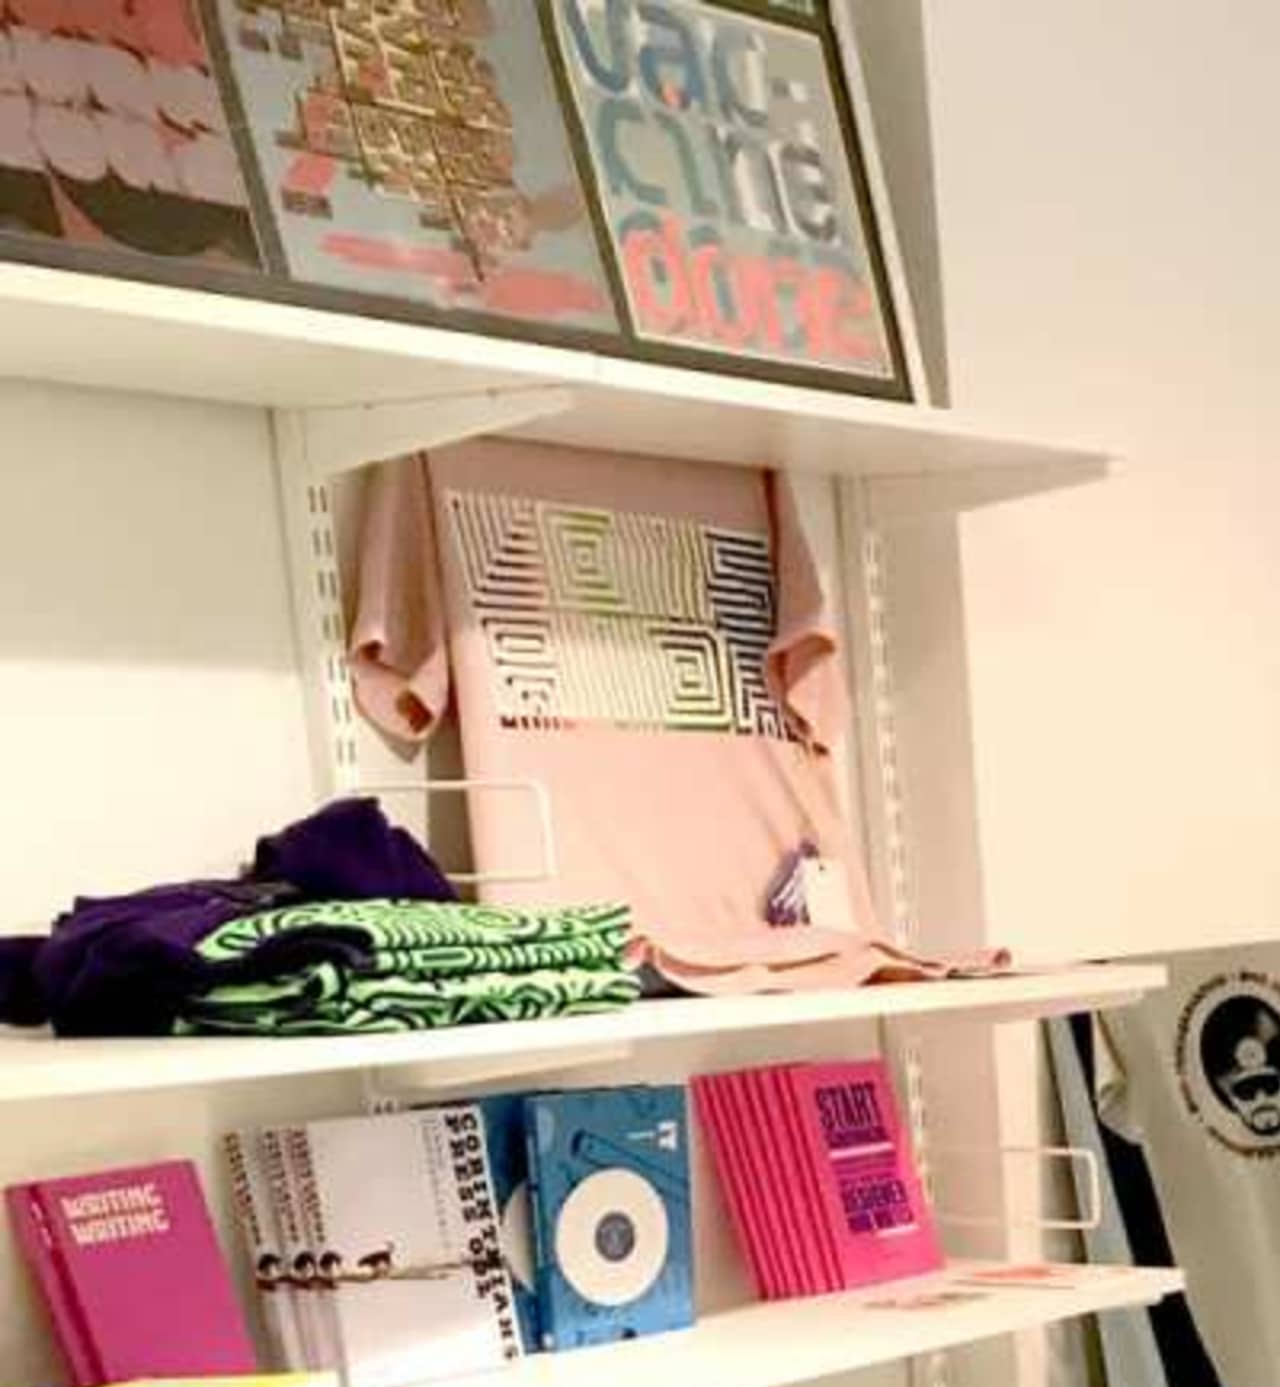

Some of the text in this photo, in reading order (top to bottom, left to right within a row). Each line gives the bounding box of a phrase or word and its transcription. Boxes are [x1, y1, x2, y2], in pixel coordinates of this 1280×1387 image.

[813, 1082, 882, 1132] START
[60, 1183, 163, 1219] WRITING
[69, 1208, 170, 1245] WRITING
